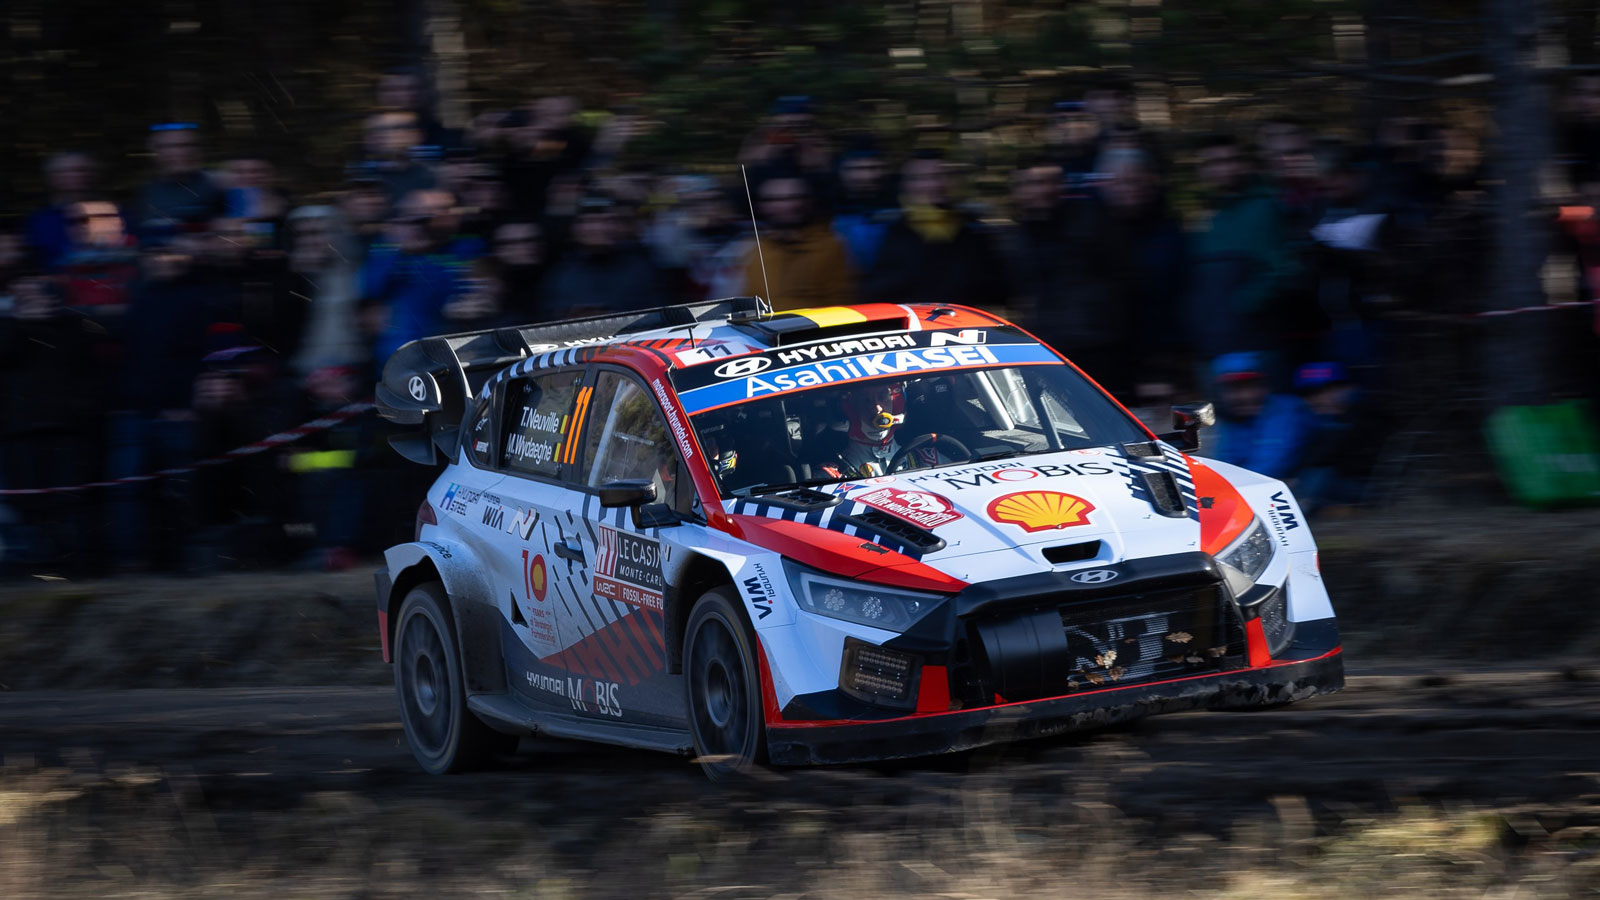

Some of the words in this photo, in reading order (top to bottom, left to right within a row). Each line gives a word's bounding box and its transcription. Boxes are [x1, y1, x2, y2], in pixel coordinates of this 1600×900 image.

[696, 344, 733, 359] 11
[778, 335, 917, 364] HYUNDAI
[746, 346, 999, 398] AsahiKASEI
[520, 406, 560, 433] T.Neuville
[563, 386, 594, 464] 11
[651, 378, 694, 459] motorsport.hyundai.com
[505, 433, 552, 464] M.Wydaeghe
[907, 462, 1025, 483] HYUNDAI
[943, 462, 1115, 491] MOBIS
[450, 500, 467, 516] STEEL
[619, 537, 630, 560] LE
[596, 581, 616, 596] WRC
[753, 562, 776, 597] HYUNDAI
[622, 587, 656, 608] FOSSIL-FREE
[526, 671, 565, 696] HYUNDAI
[567, 677, 622, 717] MOBIS
